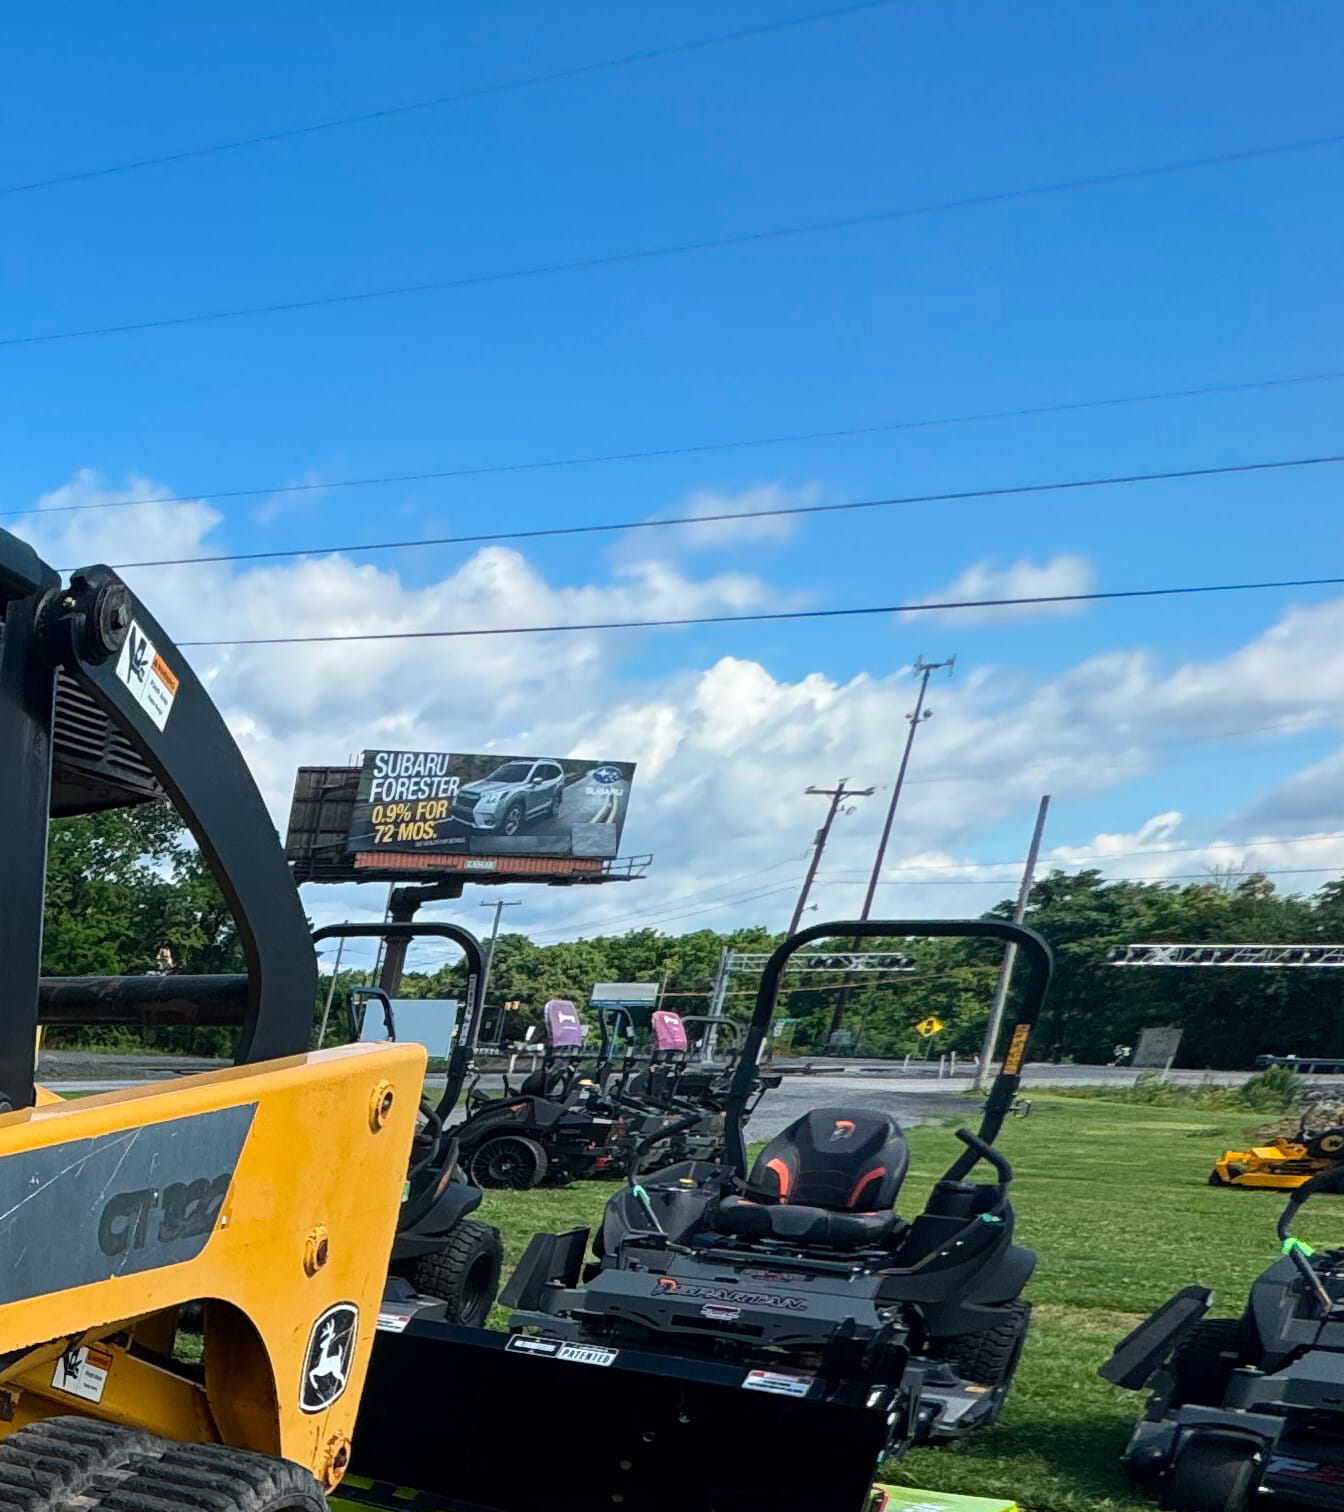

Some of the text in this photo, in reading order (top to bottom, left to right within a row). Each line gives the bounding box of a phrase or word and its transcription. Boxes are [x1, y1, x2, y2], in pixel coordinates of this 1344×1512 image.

[373, 752, 449, 778] SUBARU
[369, 776, 460, 802] FORESTER
[372, 800, 448, 824] 0.9% FOR
[374, 824, 395, 844] 72
[397, 821, 437, 841] MOS.
[561, 1348, 611, 1364] PATENTED
